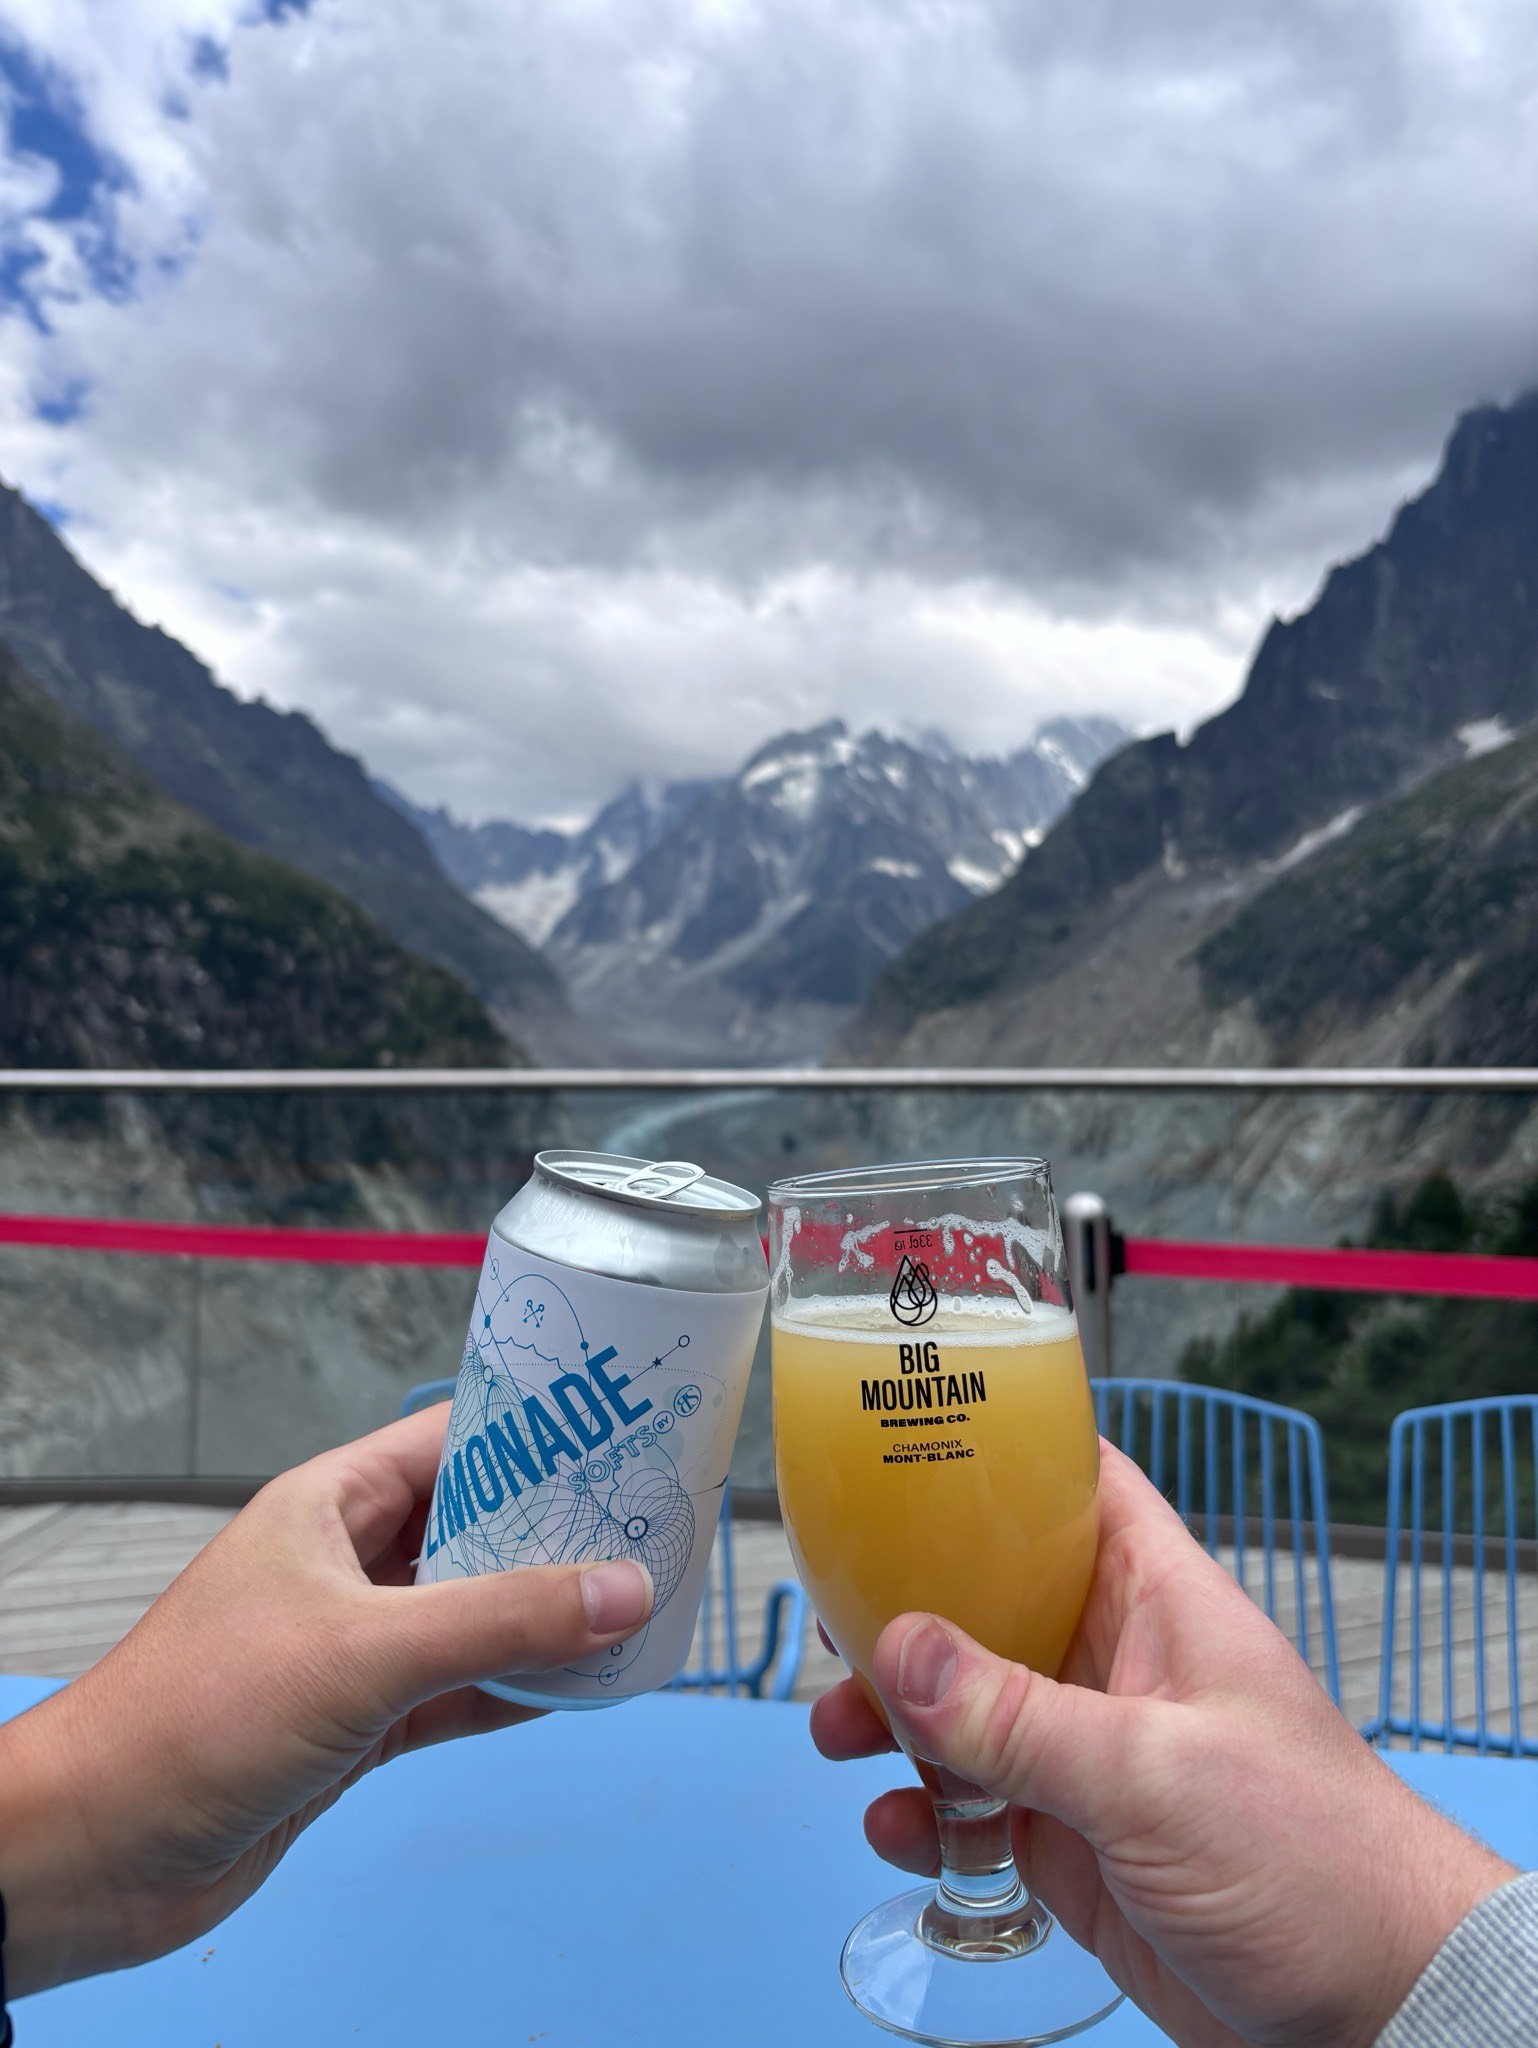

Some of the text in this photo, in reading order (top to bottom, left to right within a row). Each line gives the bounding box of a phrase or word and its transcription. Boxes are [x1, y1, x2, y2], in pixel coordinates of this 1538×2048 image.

[898, 1341, 941, 1375] BIG
[860, 1370, 987, 1412] MOUNTAIN
[880, 1413, 971, 1428] BREWING CO.
[426, 1345, 654, 1561] LIMONADE
[567, 1424, 658, 1496] SOFTS
[882, 1448, 975, 1464] MONT-BLANC
[892, 1439, 963, 1453] CHAMONIX
